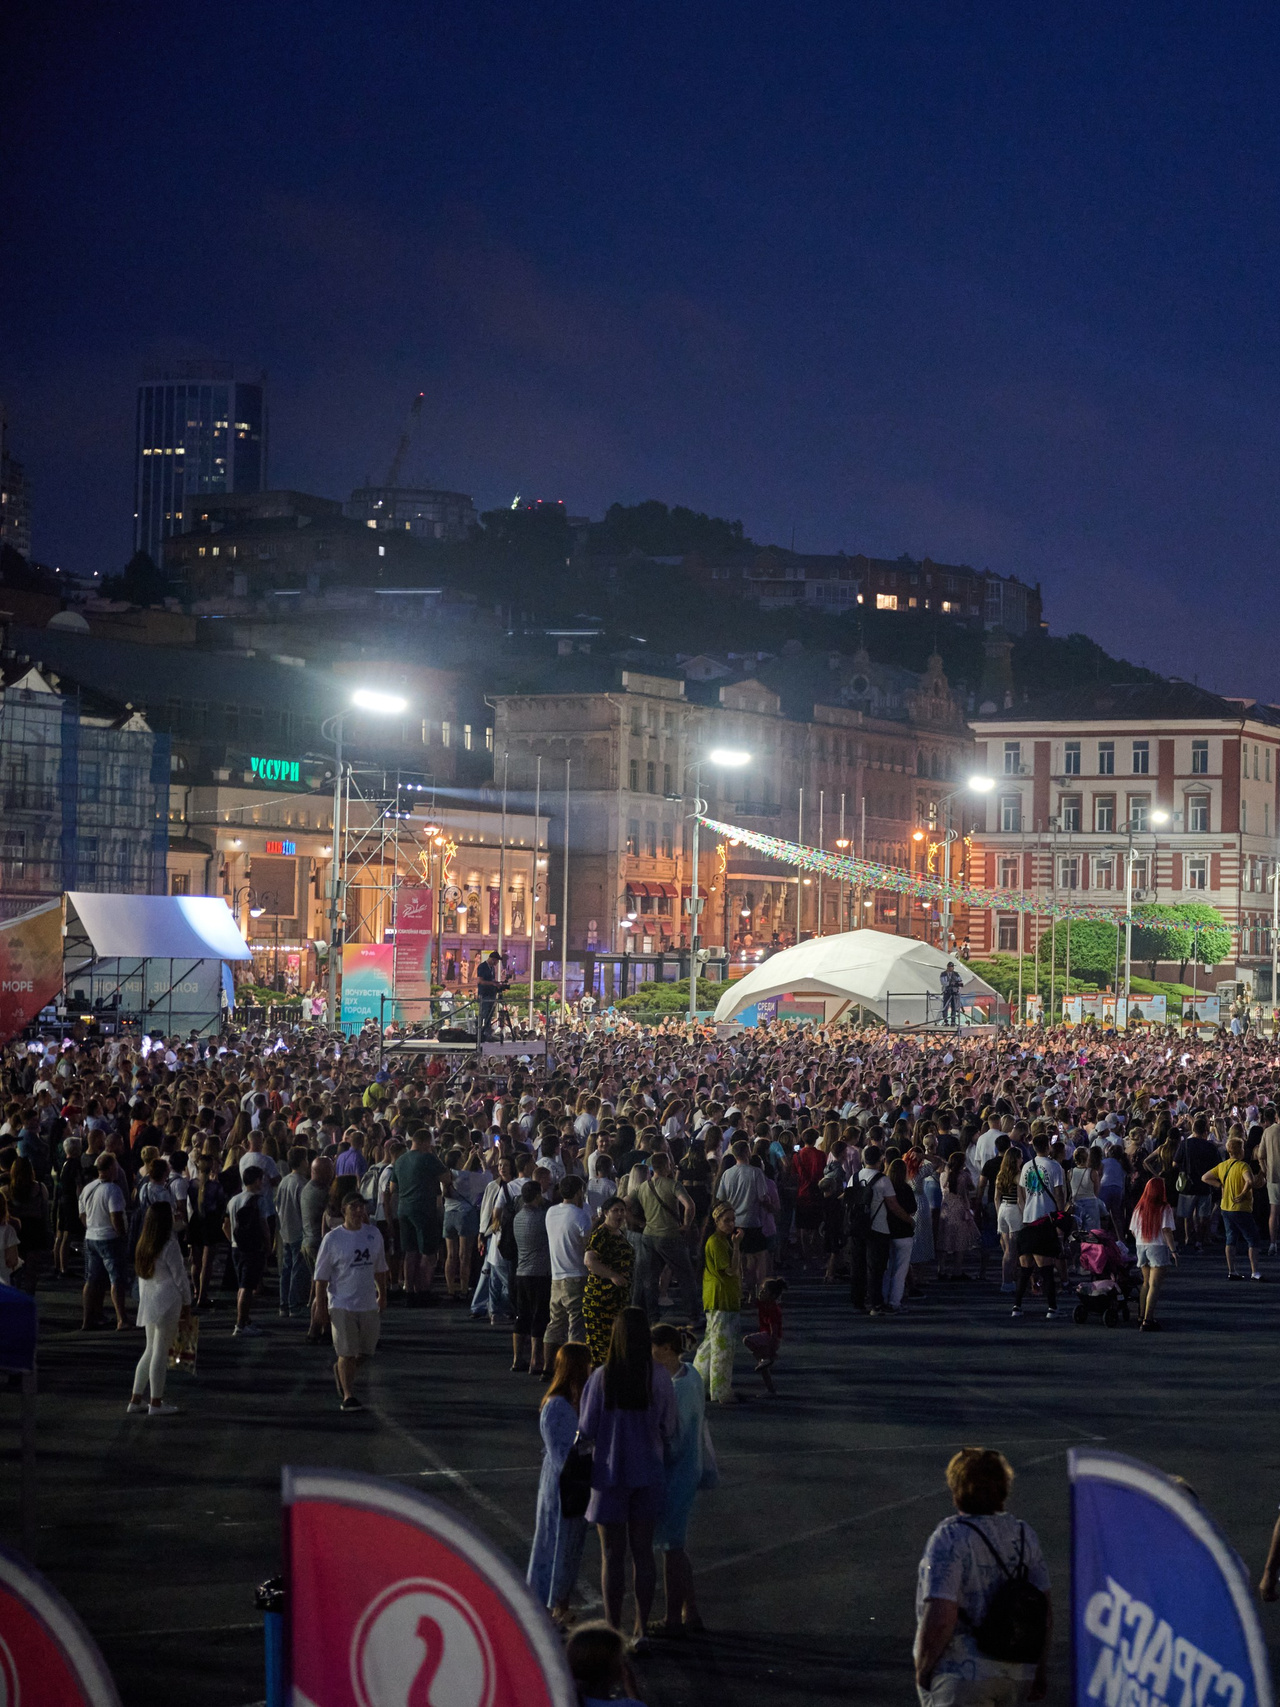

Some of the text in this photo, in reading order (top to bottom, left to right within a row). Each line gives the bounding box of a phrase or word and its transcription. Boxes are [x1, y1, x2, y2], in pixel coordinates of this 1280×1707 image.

[2, 981, 33, 992] МОРЕ
[345, 1006, 371, 1014] ГОРОДА
[757, 1002, 775, 1011] СРЕДИ
[354, 1248, 370, 1262] 24
